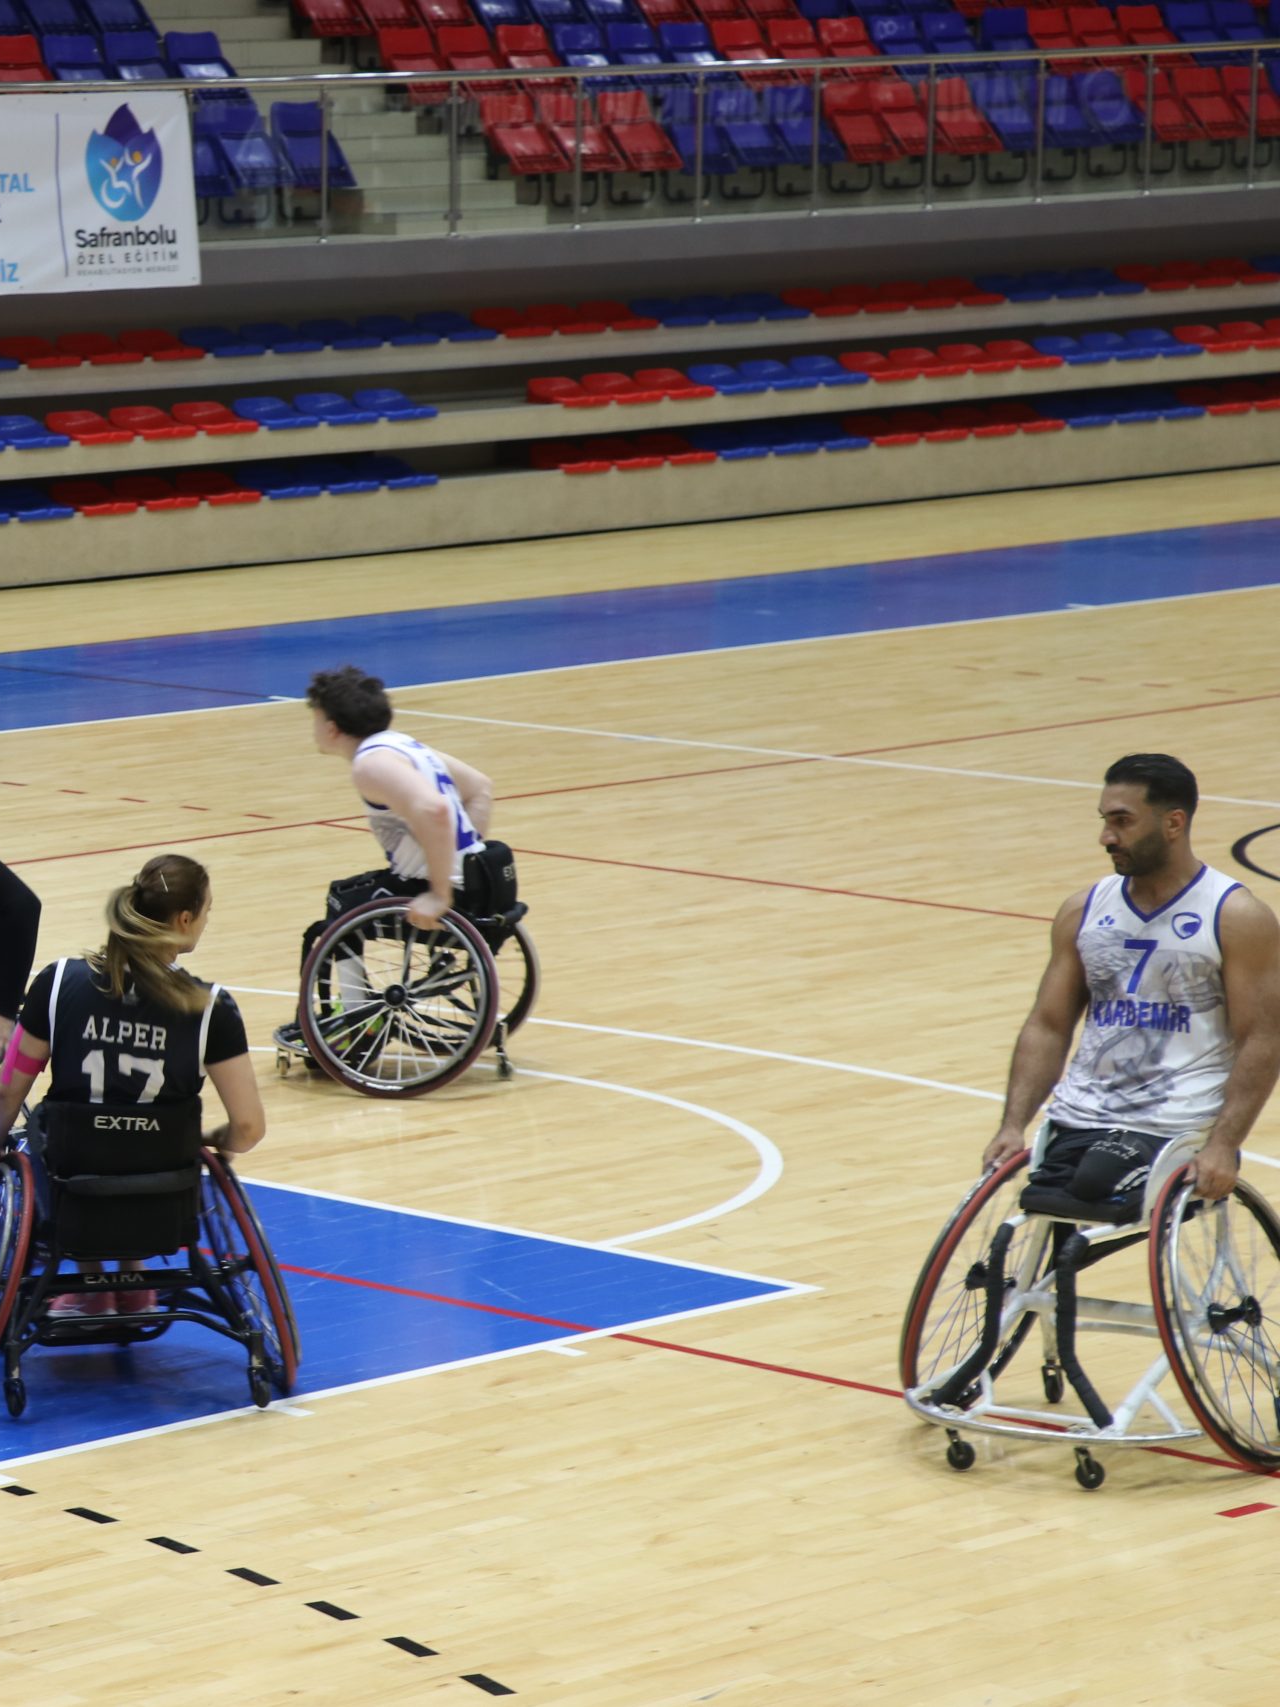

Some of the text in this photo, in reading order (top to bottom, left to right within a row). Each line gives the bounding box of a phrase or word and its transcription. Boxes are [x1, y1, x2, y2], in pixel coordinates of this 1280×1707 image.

[75, 224, 177, 248] Safranbolu
[77, 249, 179, 265] ÖZEL EĞİTİM
[1123, 939, 1159, 994] 7
[82, 1014, 167, 1051] ALPER
[81, 1049, 165, 1104] 17
[93, 1115, 160, 1131] EXTRA
